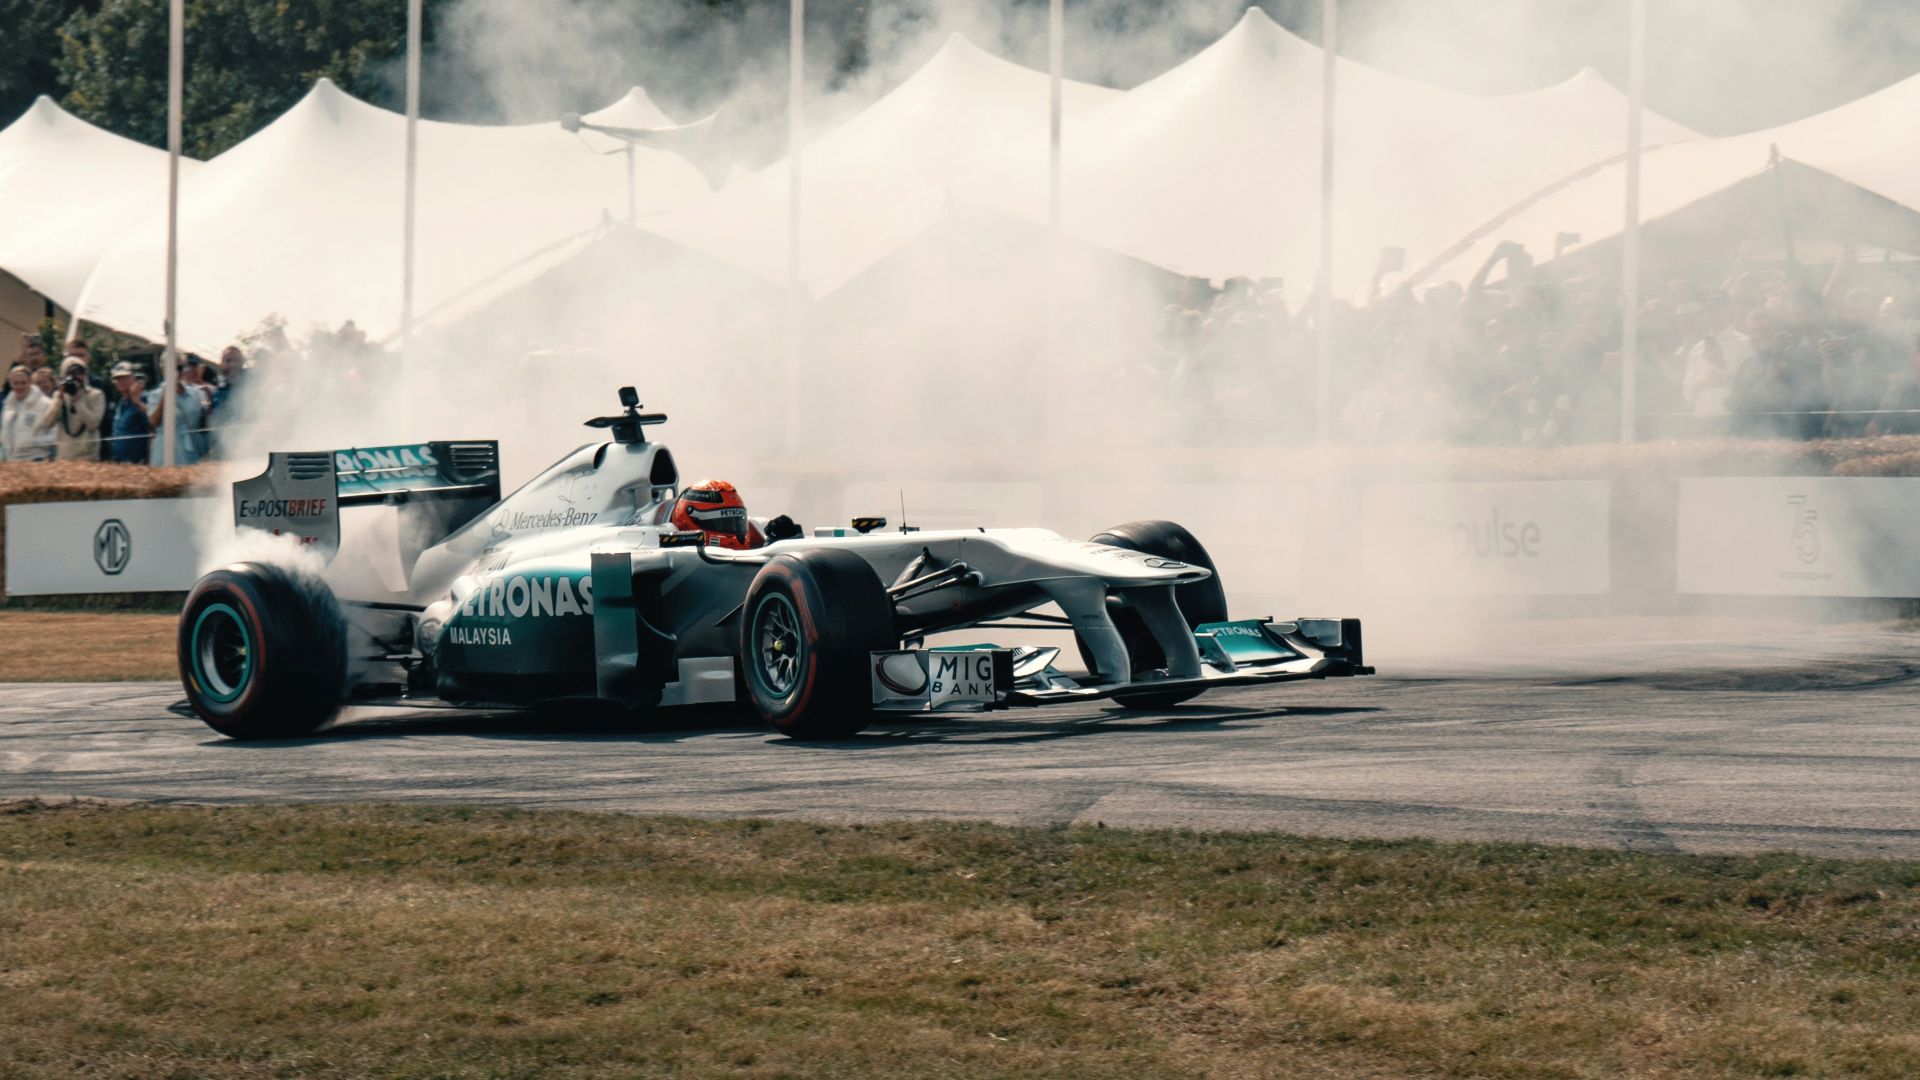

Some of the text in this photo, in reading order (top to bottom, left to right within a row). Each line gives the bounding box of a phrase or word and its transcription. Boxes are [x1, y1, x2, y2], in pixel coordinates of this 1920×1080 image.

[509, 507, 598, 531] Mercedes-Benz
[720, 509, 744, 517] PETRON
[97, 522, 130, 572] MG
[462, 575, 594, 618] ETRONAS
[450, 627, 511, 645] MALAYSIA
[936, 656, 992, 682] MIG
[932, 681, 994, 696] BANK
